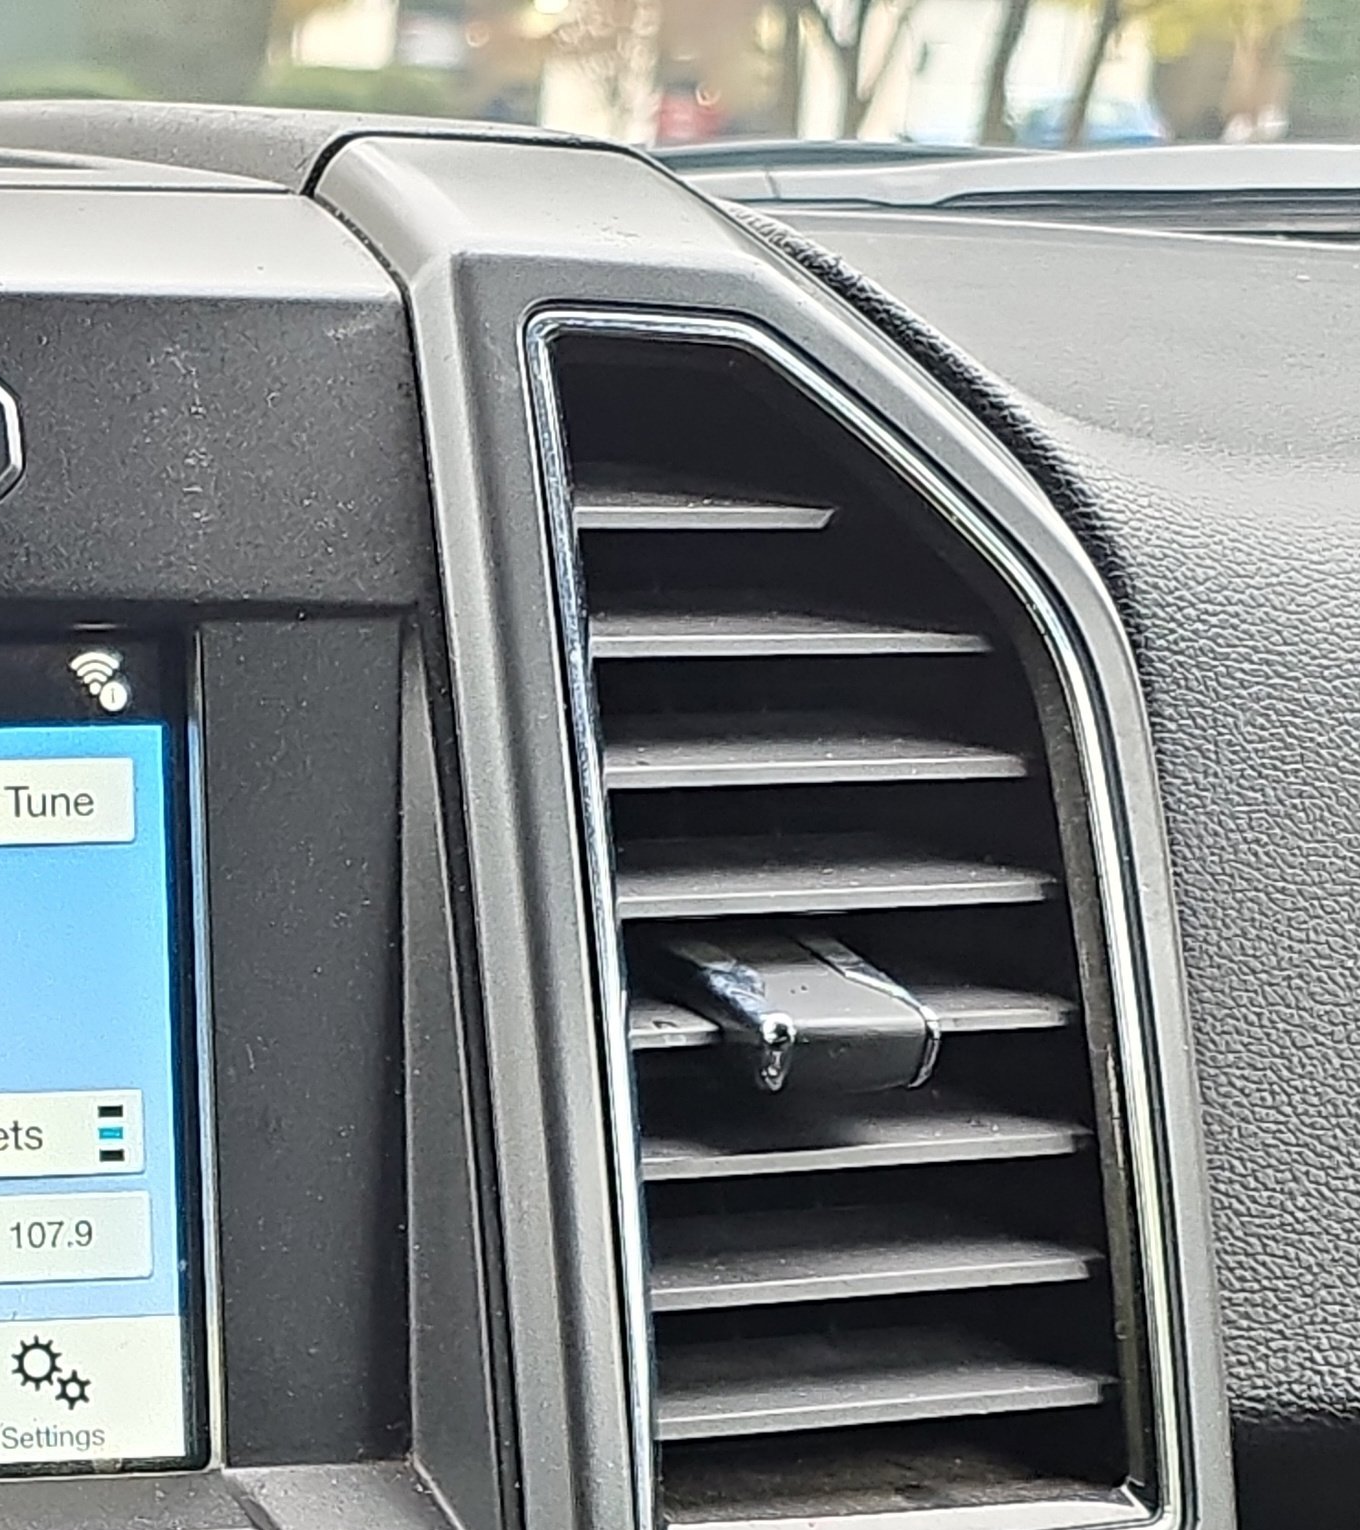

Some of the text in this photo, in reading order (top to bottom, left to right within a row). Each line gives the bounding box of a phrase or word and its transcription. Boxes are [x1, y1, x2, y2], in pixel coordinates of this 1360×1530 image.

[4, 785, 94, 818] Tune
[10, 1219, 93, 1249] 107.9
[1, 1426, 105, 1450] Settings
